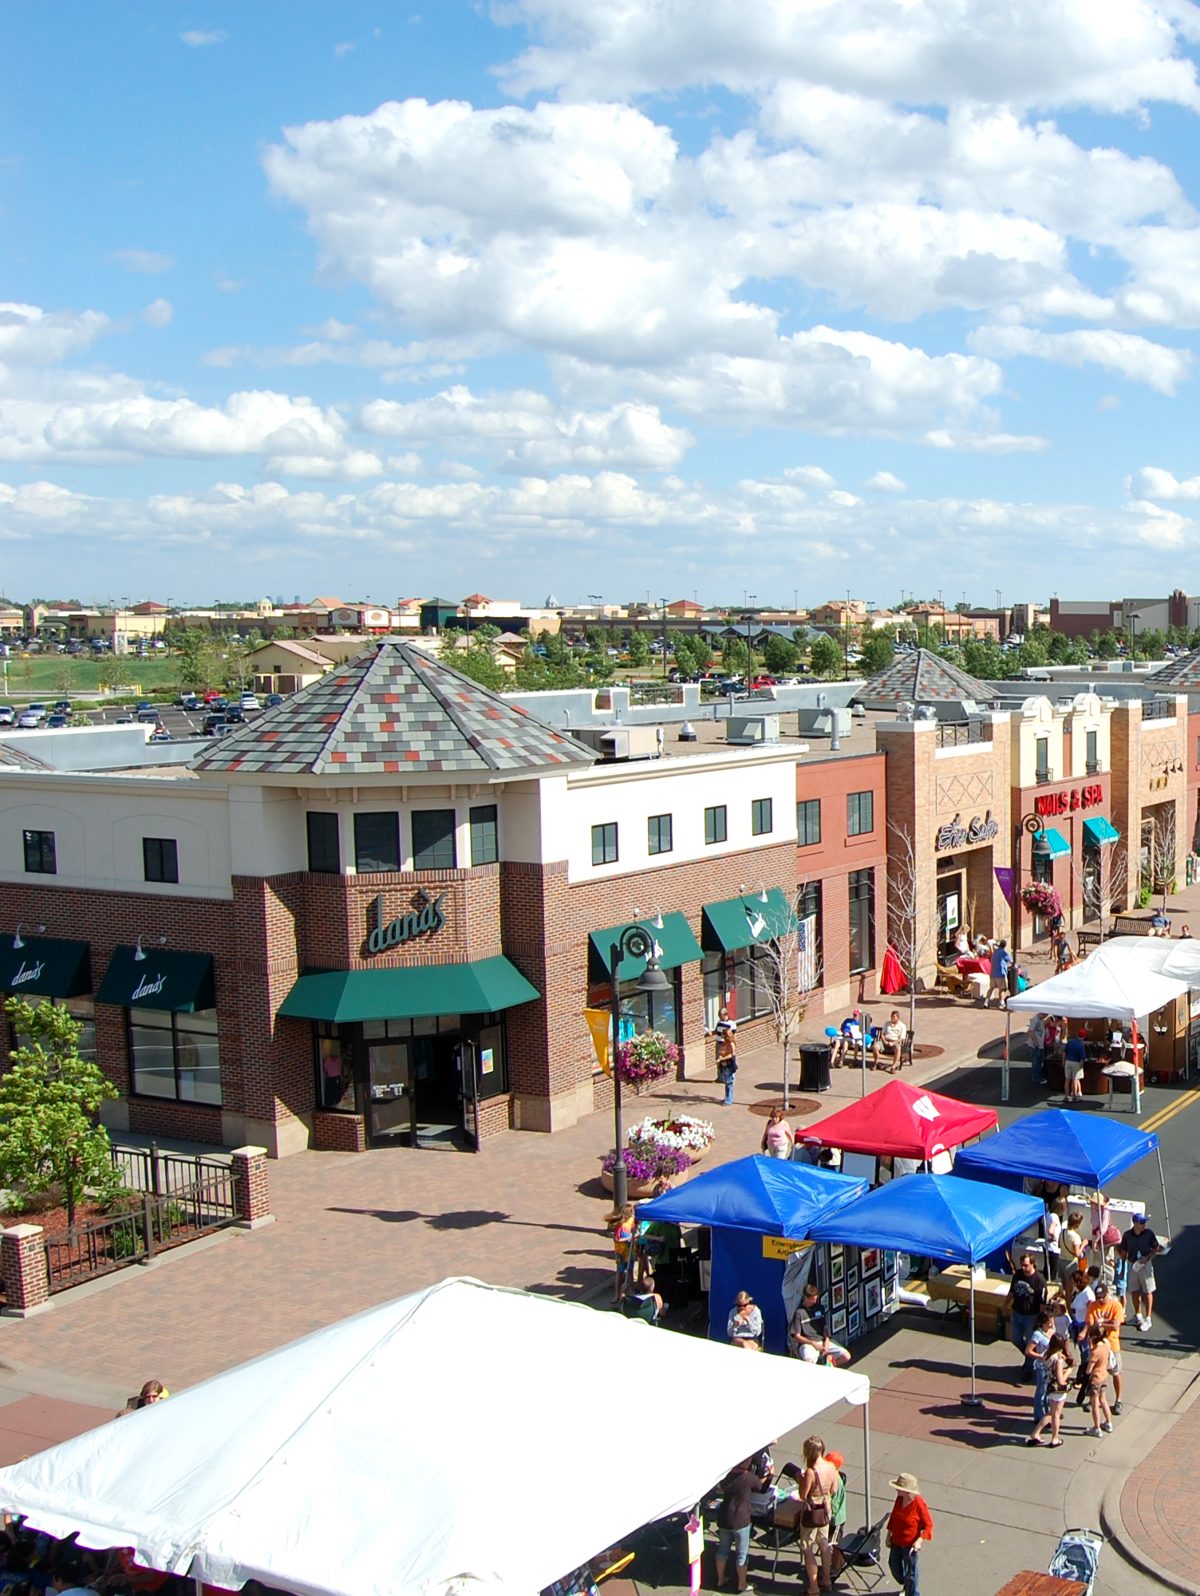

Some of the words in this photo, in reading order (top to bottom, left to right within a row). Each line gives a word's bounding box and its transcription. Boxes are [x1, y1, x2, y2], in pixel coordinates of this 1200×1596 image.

[1036, 790, 1068, 817] NAILS
[1071, 788, 1081, 811] &
[1083, 784, 1103, 808] SPA
[369, 887, 449, 953] dana's
[11, 960, 46, 986] dana's
[131, 973, 168, 1000] dana's
